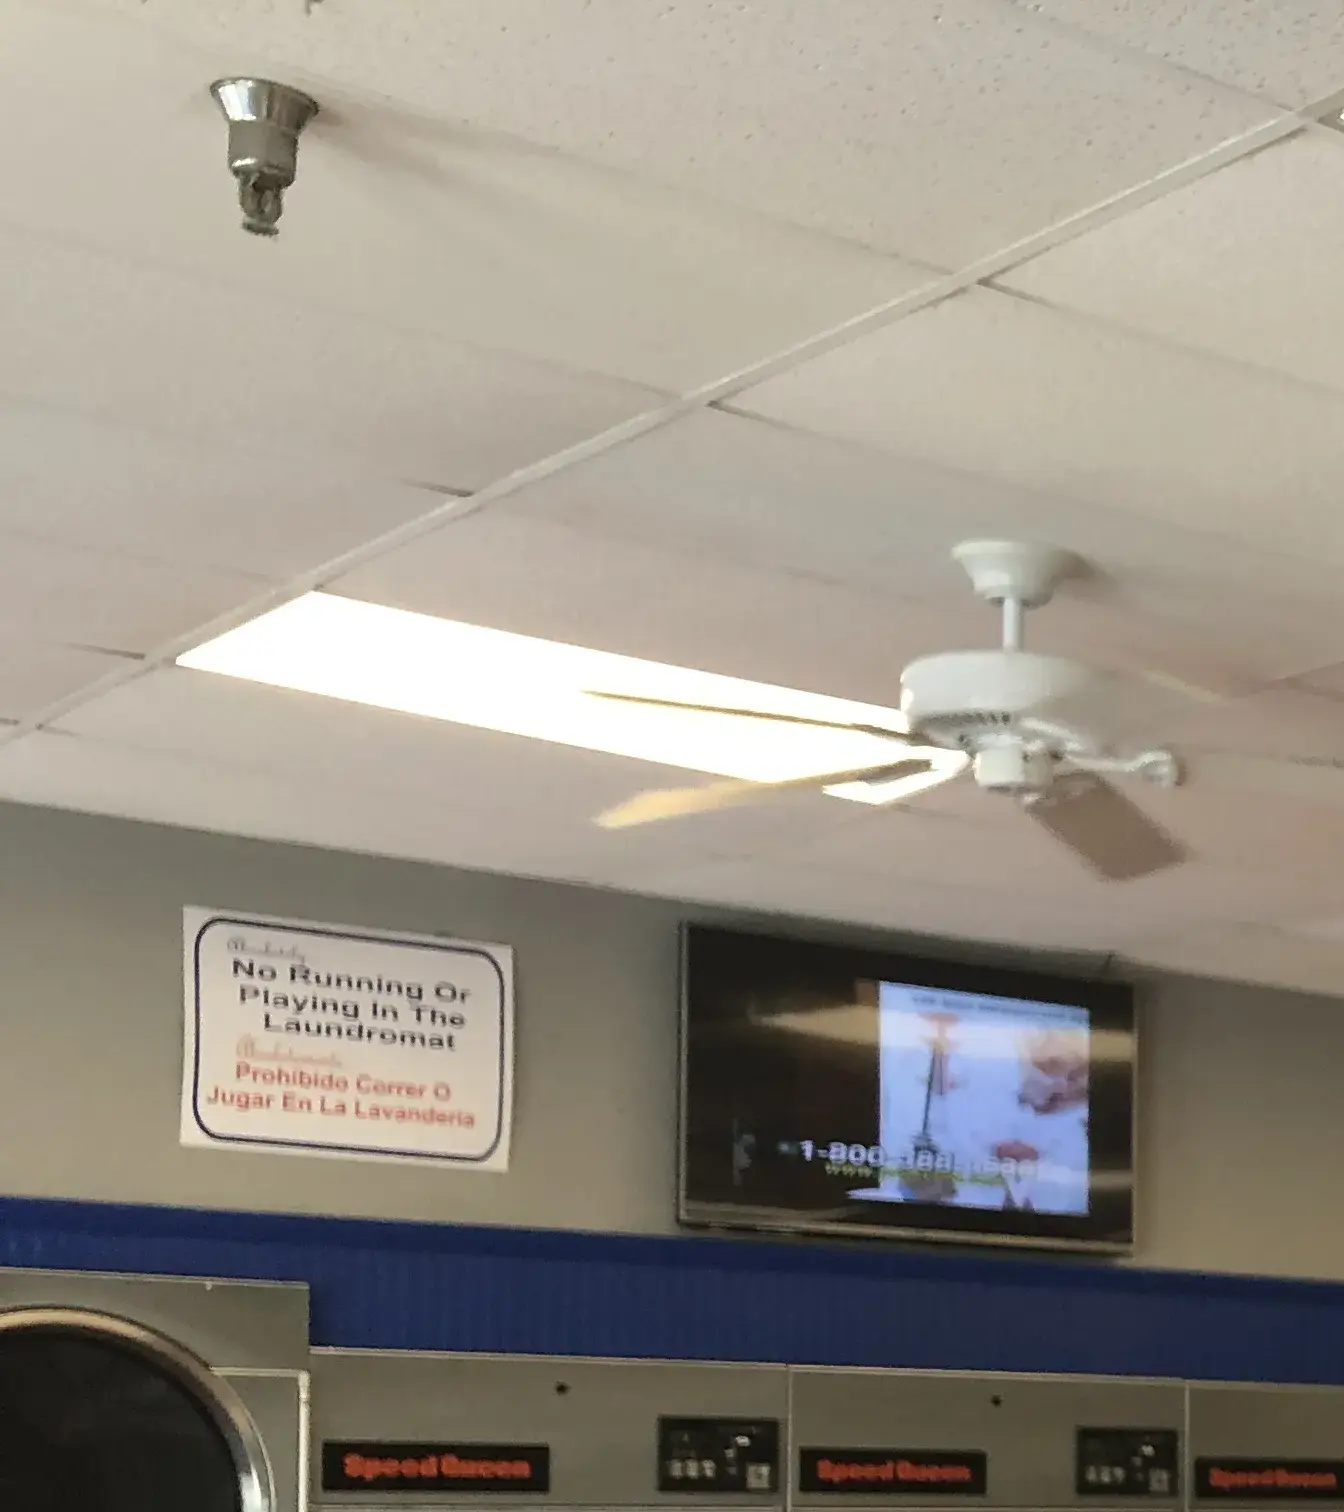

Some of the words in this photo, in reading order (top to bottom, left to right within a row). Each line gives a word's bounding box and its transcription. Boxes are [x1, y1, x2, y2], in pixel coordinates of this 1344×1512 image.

[232, 959, 277, 981] No
[289, 964, 423, 1001] Running
[434, 981, 471, 1004] Or
[239, 985, 359, 1019] Playing
[371, 1001, 399, 1021] In
[412, 1003, 465, 1028] The
[264, 1014, 455, 1051] Laundromat
[236, 1061, 348, 1089] Prohibido
[207, 1086, 275, 1112] Jugar
[282, 1091, 312, 1112] En
[320, 1096, 346, 1116] La
